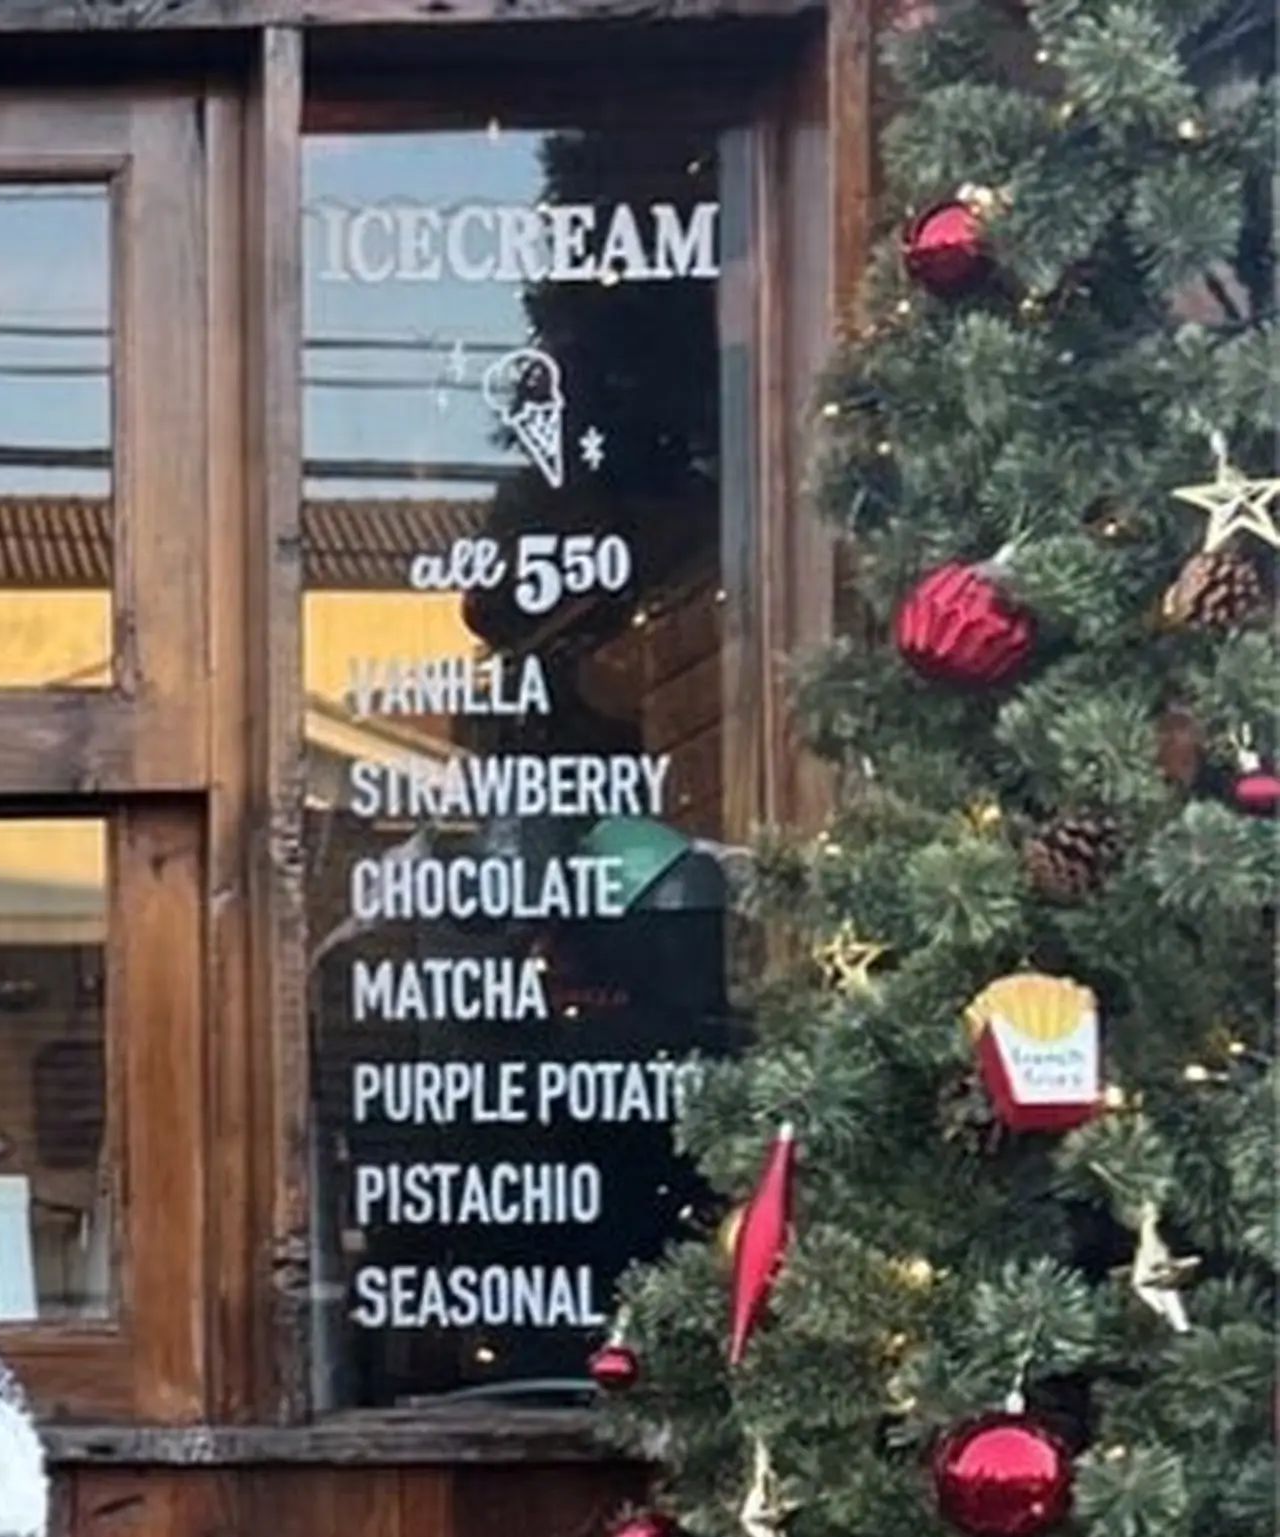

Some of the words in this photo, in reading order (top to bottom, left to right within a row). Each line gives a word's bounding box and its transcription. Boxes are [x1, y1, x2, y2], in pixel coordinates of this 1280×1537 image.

[320, 203, 721, 283] ICECREAM
[410, 536, 508, 590] all
[350, 755, 672, 818] STRAWBERRY
[351, 856, 626, 919] CHOCOLATE
[352, 956, 549, 1021] MATCHA
[353, 1061, 529, 1124] PURPLE
[356, 1162, 602, 1225] PISTACHIO
[352, 1264, 608, 1328] SEASONAL
